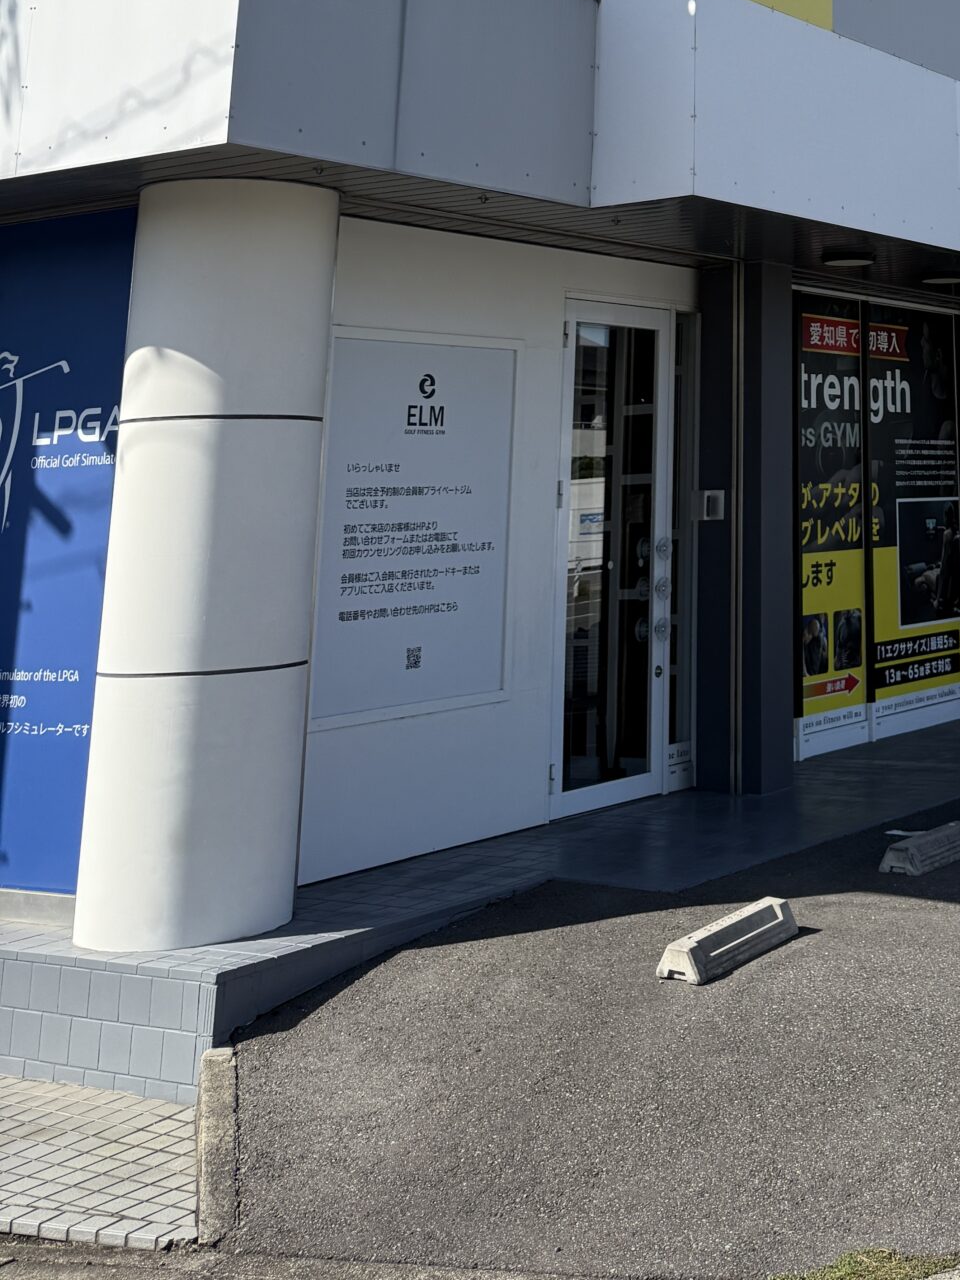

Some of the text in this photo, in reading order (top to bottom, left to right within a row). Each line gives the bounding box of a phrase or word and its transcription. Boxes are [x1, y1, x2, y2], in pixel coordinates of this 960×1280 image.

[801, 363, 912, 424] trength
[32, 405, 119, 446] LPGA
[407, 405, 445, 427] ELM
[820, 422, 860, 448] GYM
[31, 452, 116, 469] Official Golf Simulat
[347, 463, 400, 473] いらっしゃいませ
[0, 669, 79, 682] imulator of the LPGA
